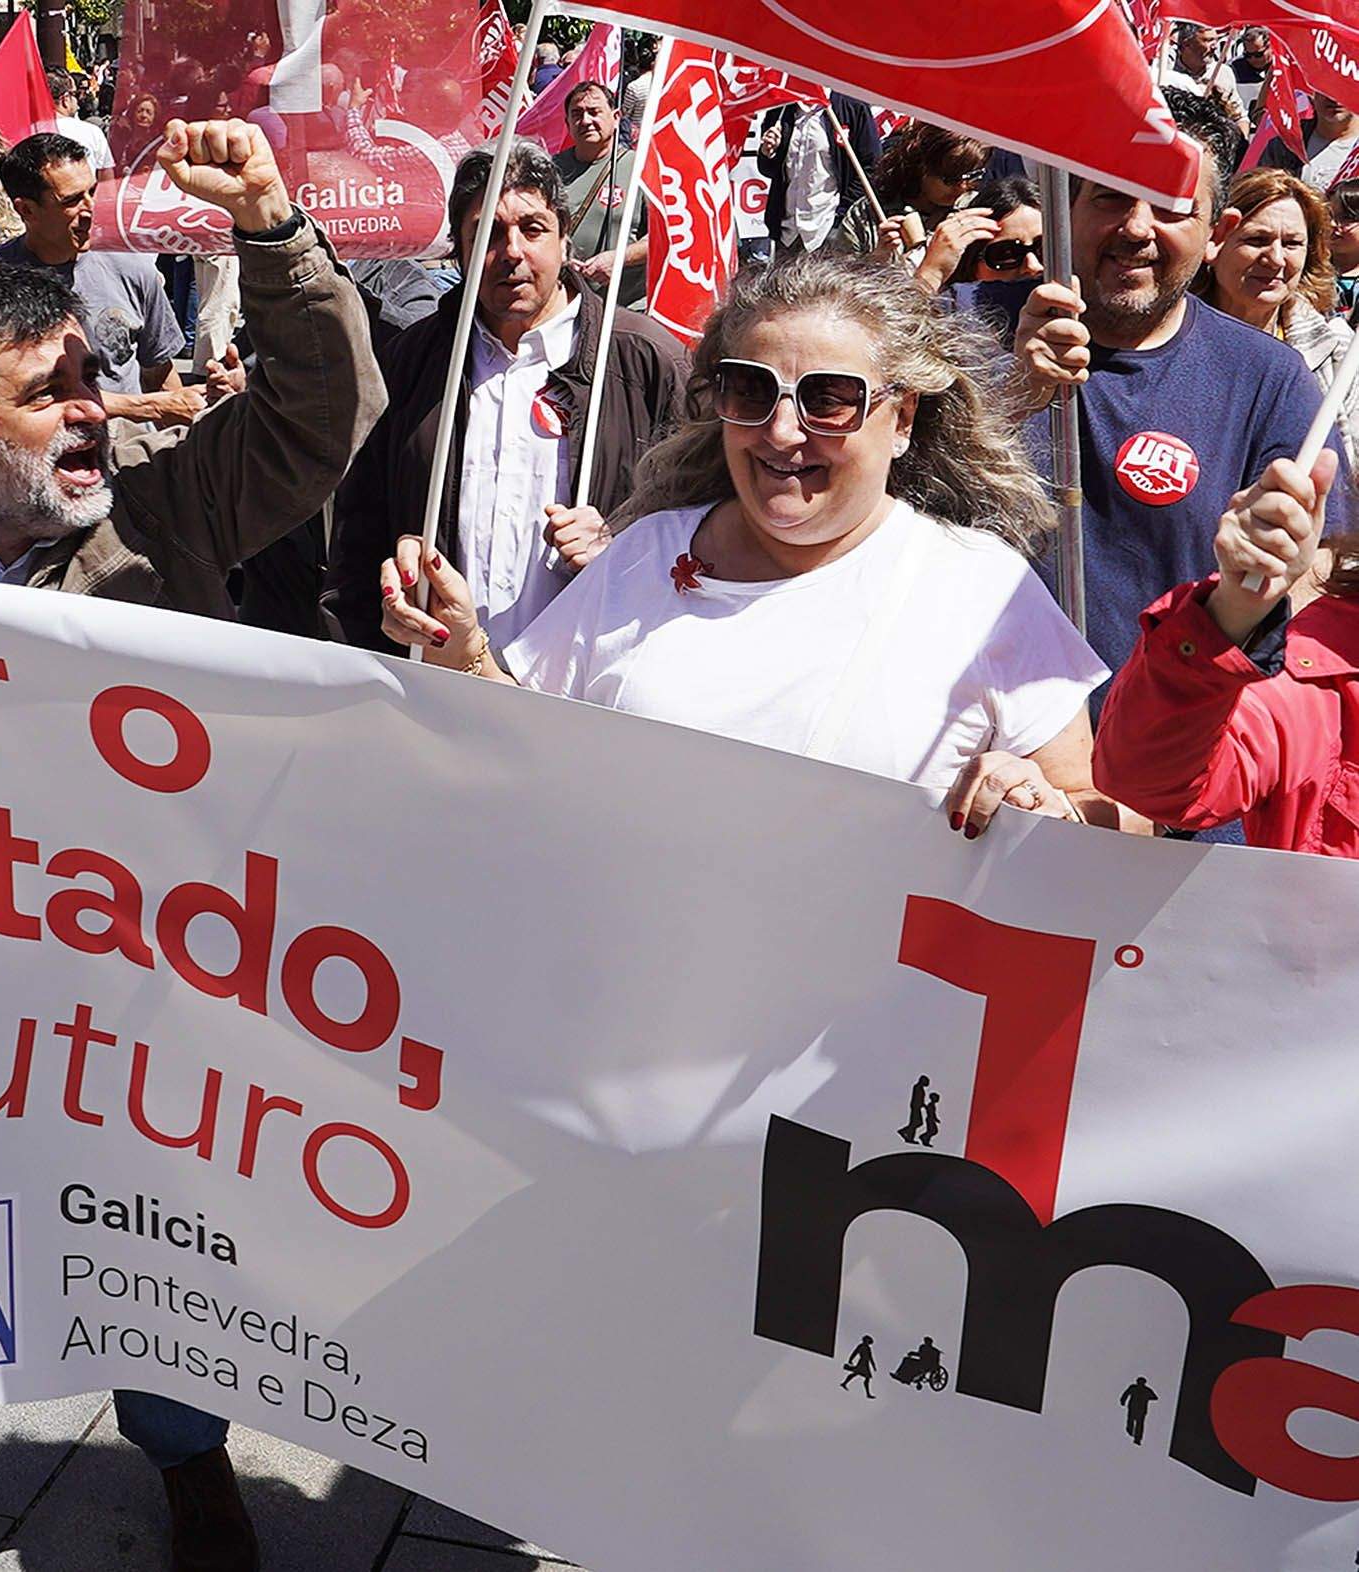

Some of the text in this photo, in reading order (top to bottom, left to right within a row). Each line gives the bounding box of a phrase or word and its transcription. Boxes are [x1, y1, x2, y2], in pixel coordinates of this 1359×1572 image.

[296, 176, 405, 212] Galicia
[318, 215, 403, 236] NTEVEDRA
[1125, 435, 1193, 481] UGT
[89, 685, 212, 794] o
[60, 1183, 239, 1266] Galicia
[61, 1254, 362, 1386] Pontevedra,
[60, 1315, 429, 1463] Arousa e Deza
